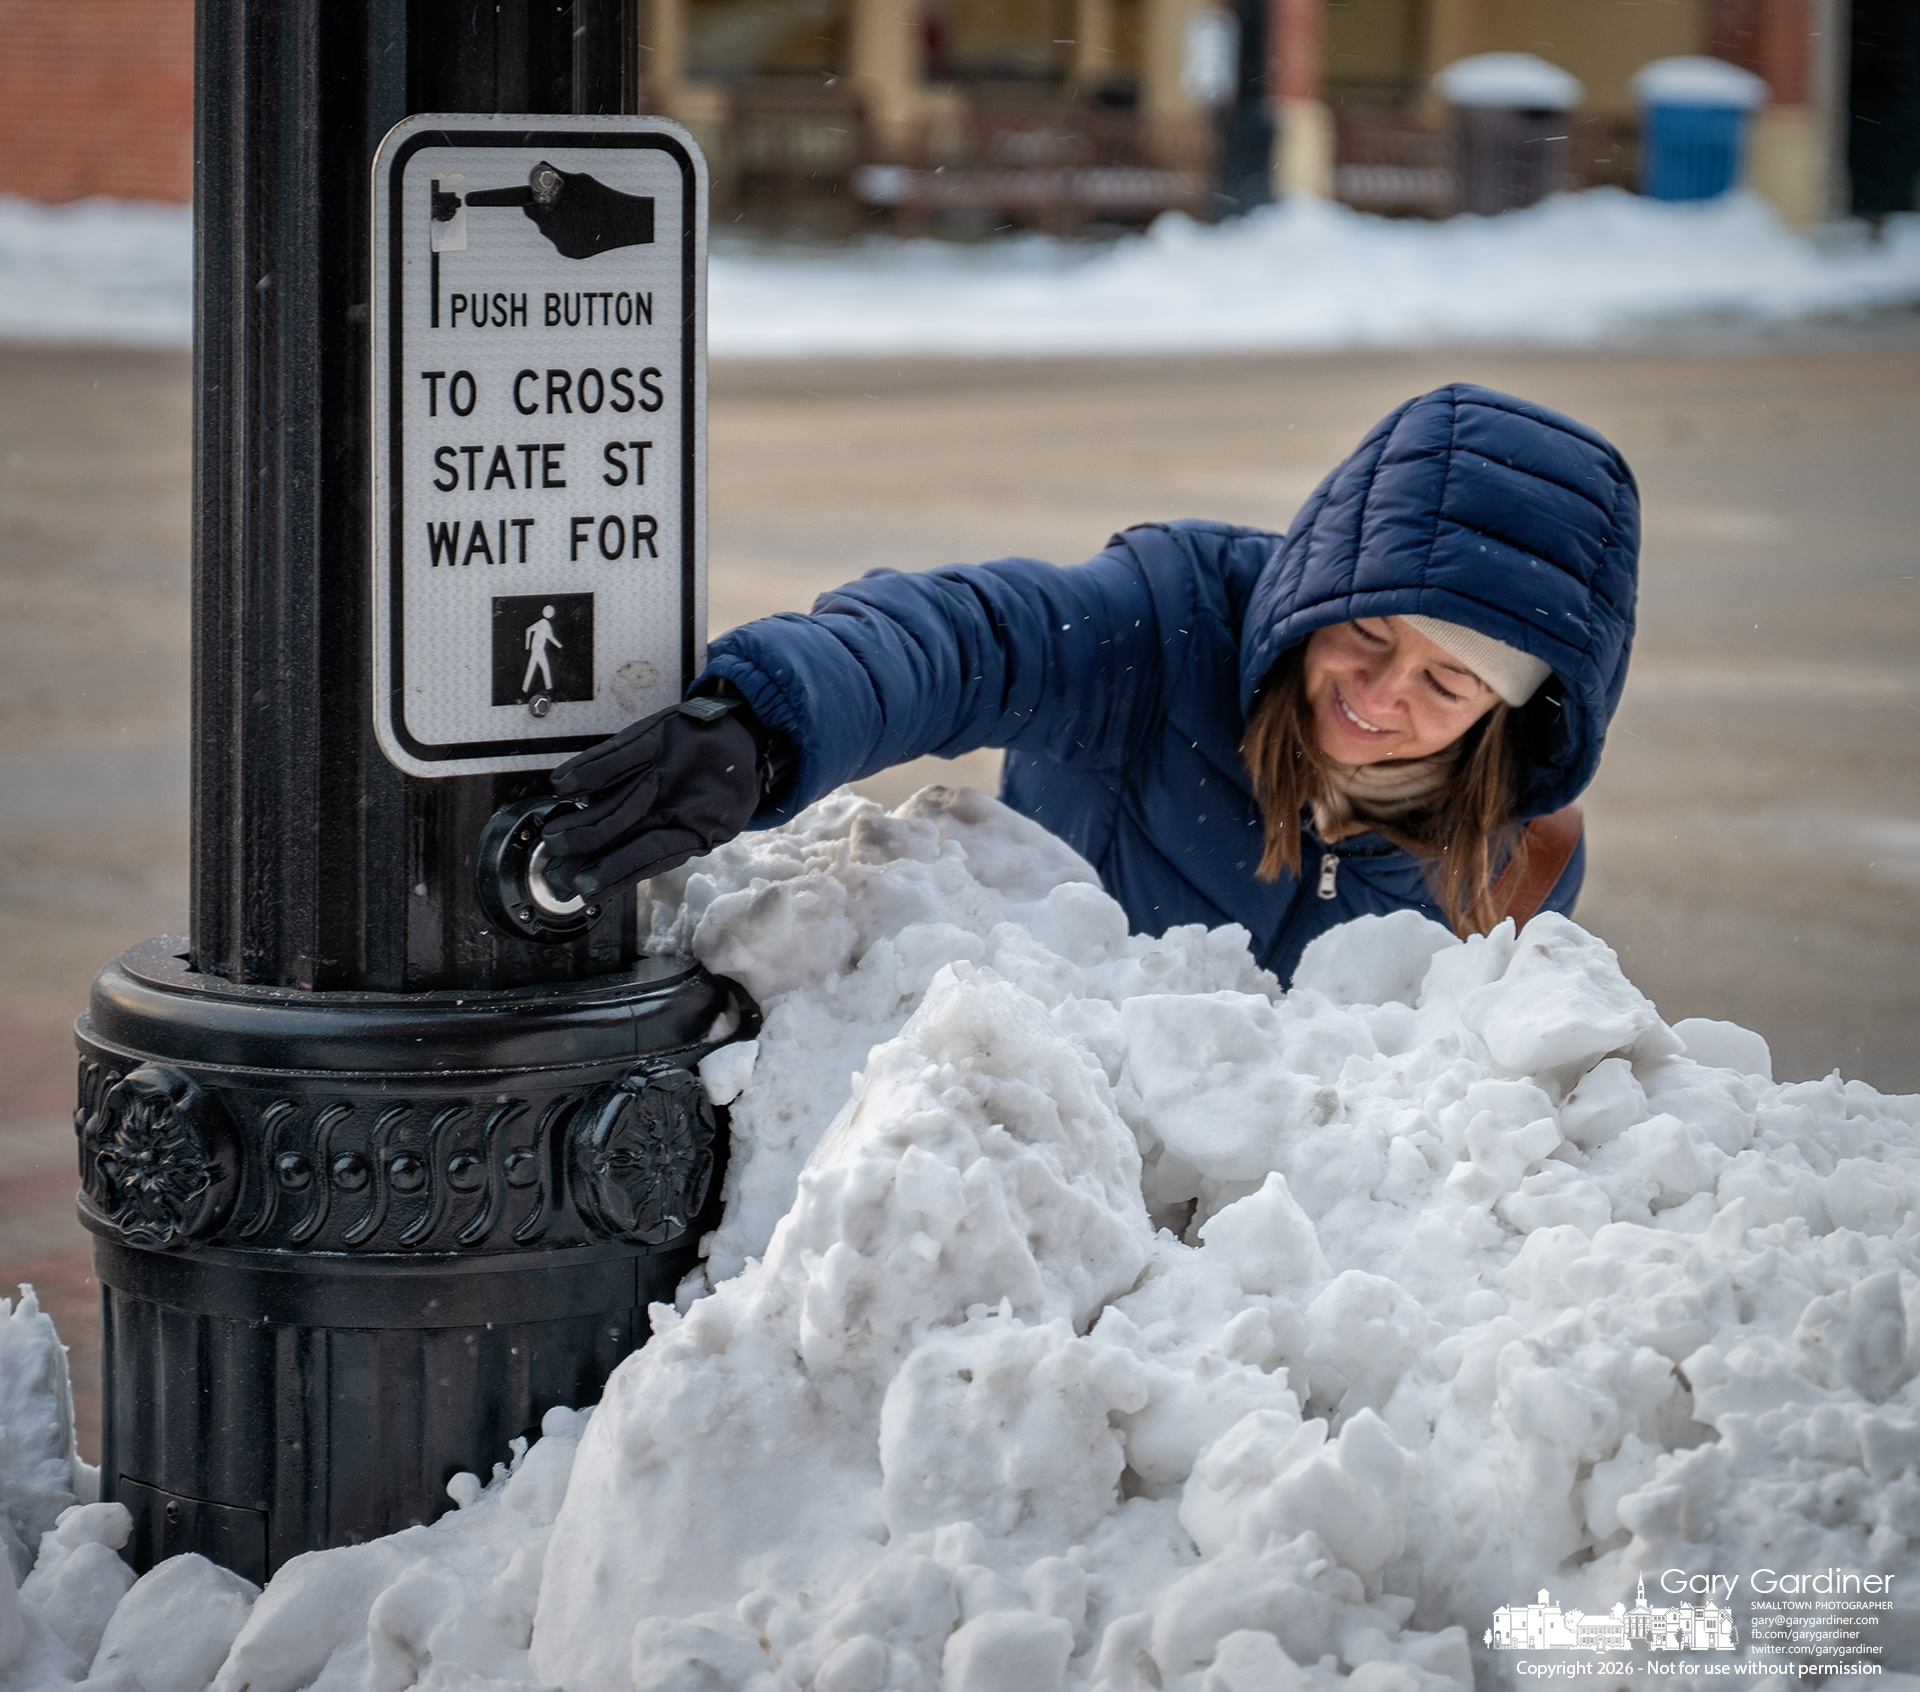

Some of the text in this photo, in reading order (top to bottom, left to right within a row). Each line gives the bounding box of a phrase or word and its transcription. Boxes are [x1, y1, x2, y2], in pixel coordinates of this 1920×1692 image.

[451, 291, 653, 328] PUSH BUTTON
[421, 366, 664, 417] TO CROSS
[433, 440, 653, 493] STATE ST
[426, 514, 659, 568] WAIT FOR
